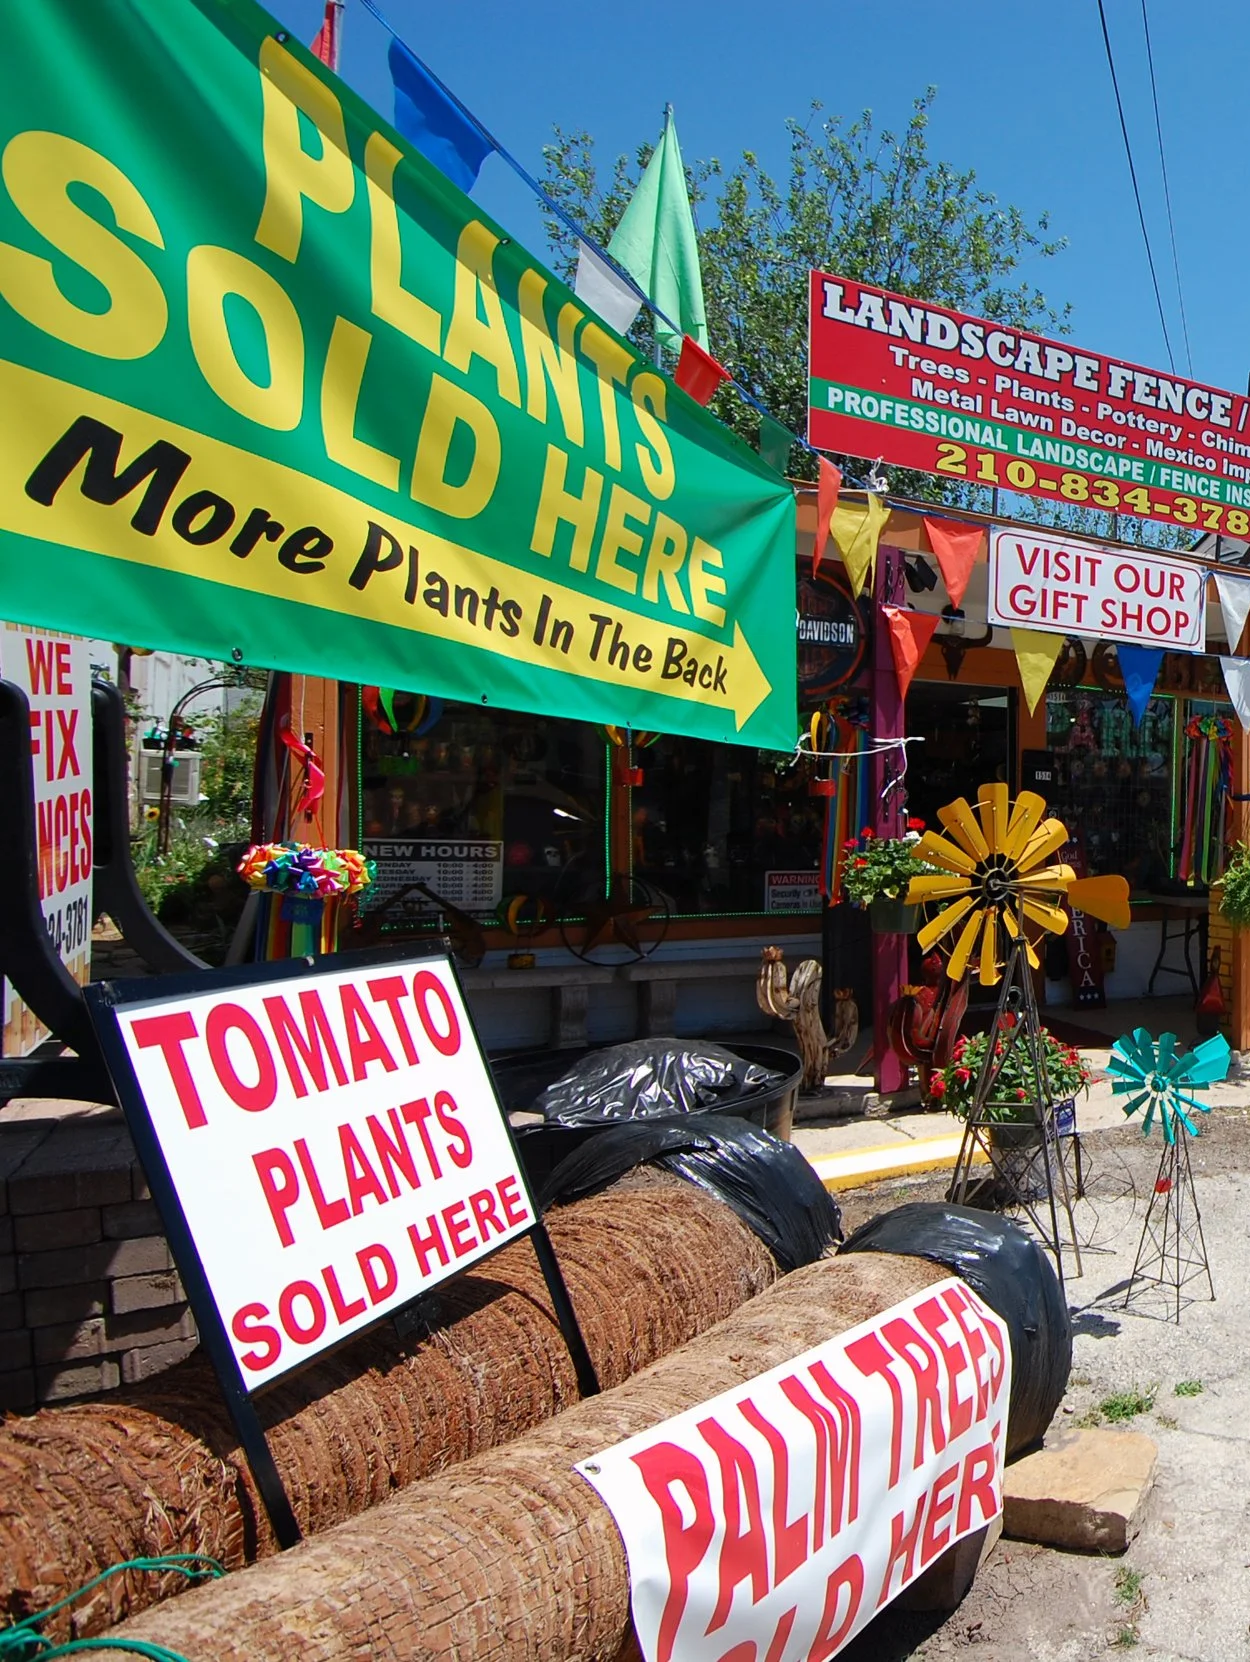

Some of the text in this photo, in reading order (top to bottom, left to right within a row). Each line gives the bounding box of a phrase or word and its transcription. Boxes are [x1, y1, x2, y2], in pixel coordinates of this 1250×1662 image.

[255, 35, 677, 500] PLANTS
[0, 130, 728, 628] SOLD HERE
[822, 280, 1100, 392] LANDSCAPE
[1107, 366, 1232, 428] FENCE
[889, 345, 970, 384] Trees
[995, 374, 1075, 413] Plants
[1097, 403, 1183, 443] Pottery
[828, 386, 1009, 451] PROFESSIONAL
[1016, 432, 1144, 482] LANDSCAPE
[1159, 466, 1222, 499] FENCE
[912, 378, 983, 414] Metal
[991, 399, 1054, 431] Lawn
[1061, 418, 1127, 450] Decor
[1146, 439, 1216, 472] Mexico
[24, 415, 729, 695] More Plants In The Back
[1009, 584, 1190, 638] GIFT SHOP
[1014, 542, 1186, 603] VISIT OUR
[25, 638, 73, 696] WE
[799, 619, 854, 643] DAVIDSON
[37, 788, 92, 901] NCES
[363, 844, 497, 858] NEW HOURS
[1071, 906, 1095, 987] ERICA
[130, 969, 463, 1130] TOMATO
[251, 1091, 476, 1249] PLANTS
[231, 1172, 529, 1373] SOLD HERE
[629, 1283, 1006, 1662] PALM TREES
